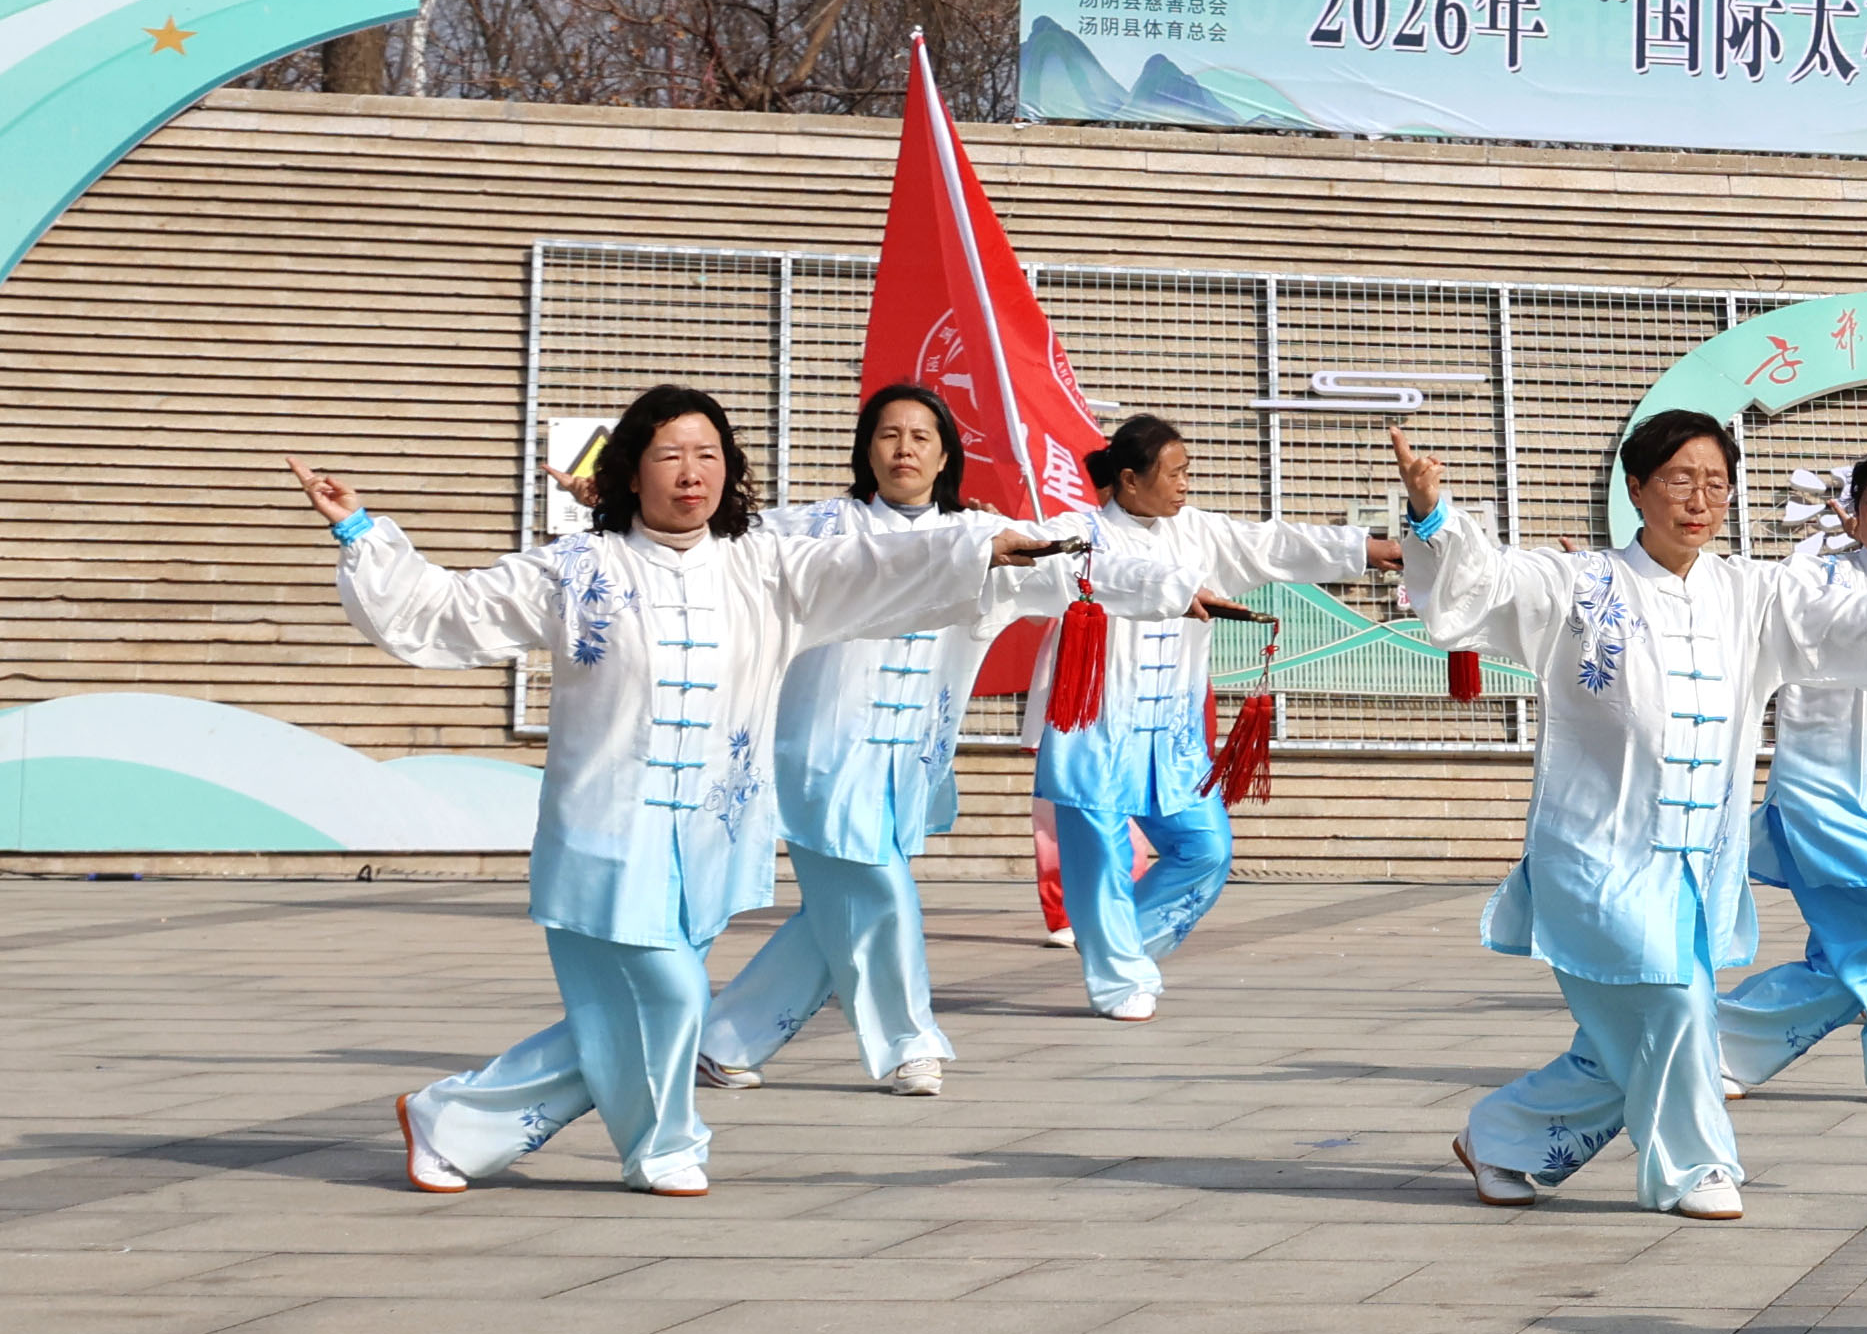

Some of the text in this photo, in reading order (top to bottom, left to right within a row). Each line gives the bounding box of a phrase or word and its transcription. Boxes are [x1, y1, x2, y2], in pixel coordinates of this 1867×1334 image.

[1078, 15, 1228, 43] 汤阴县体育总会
